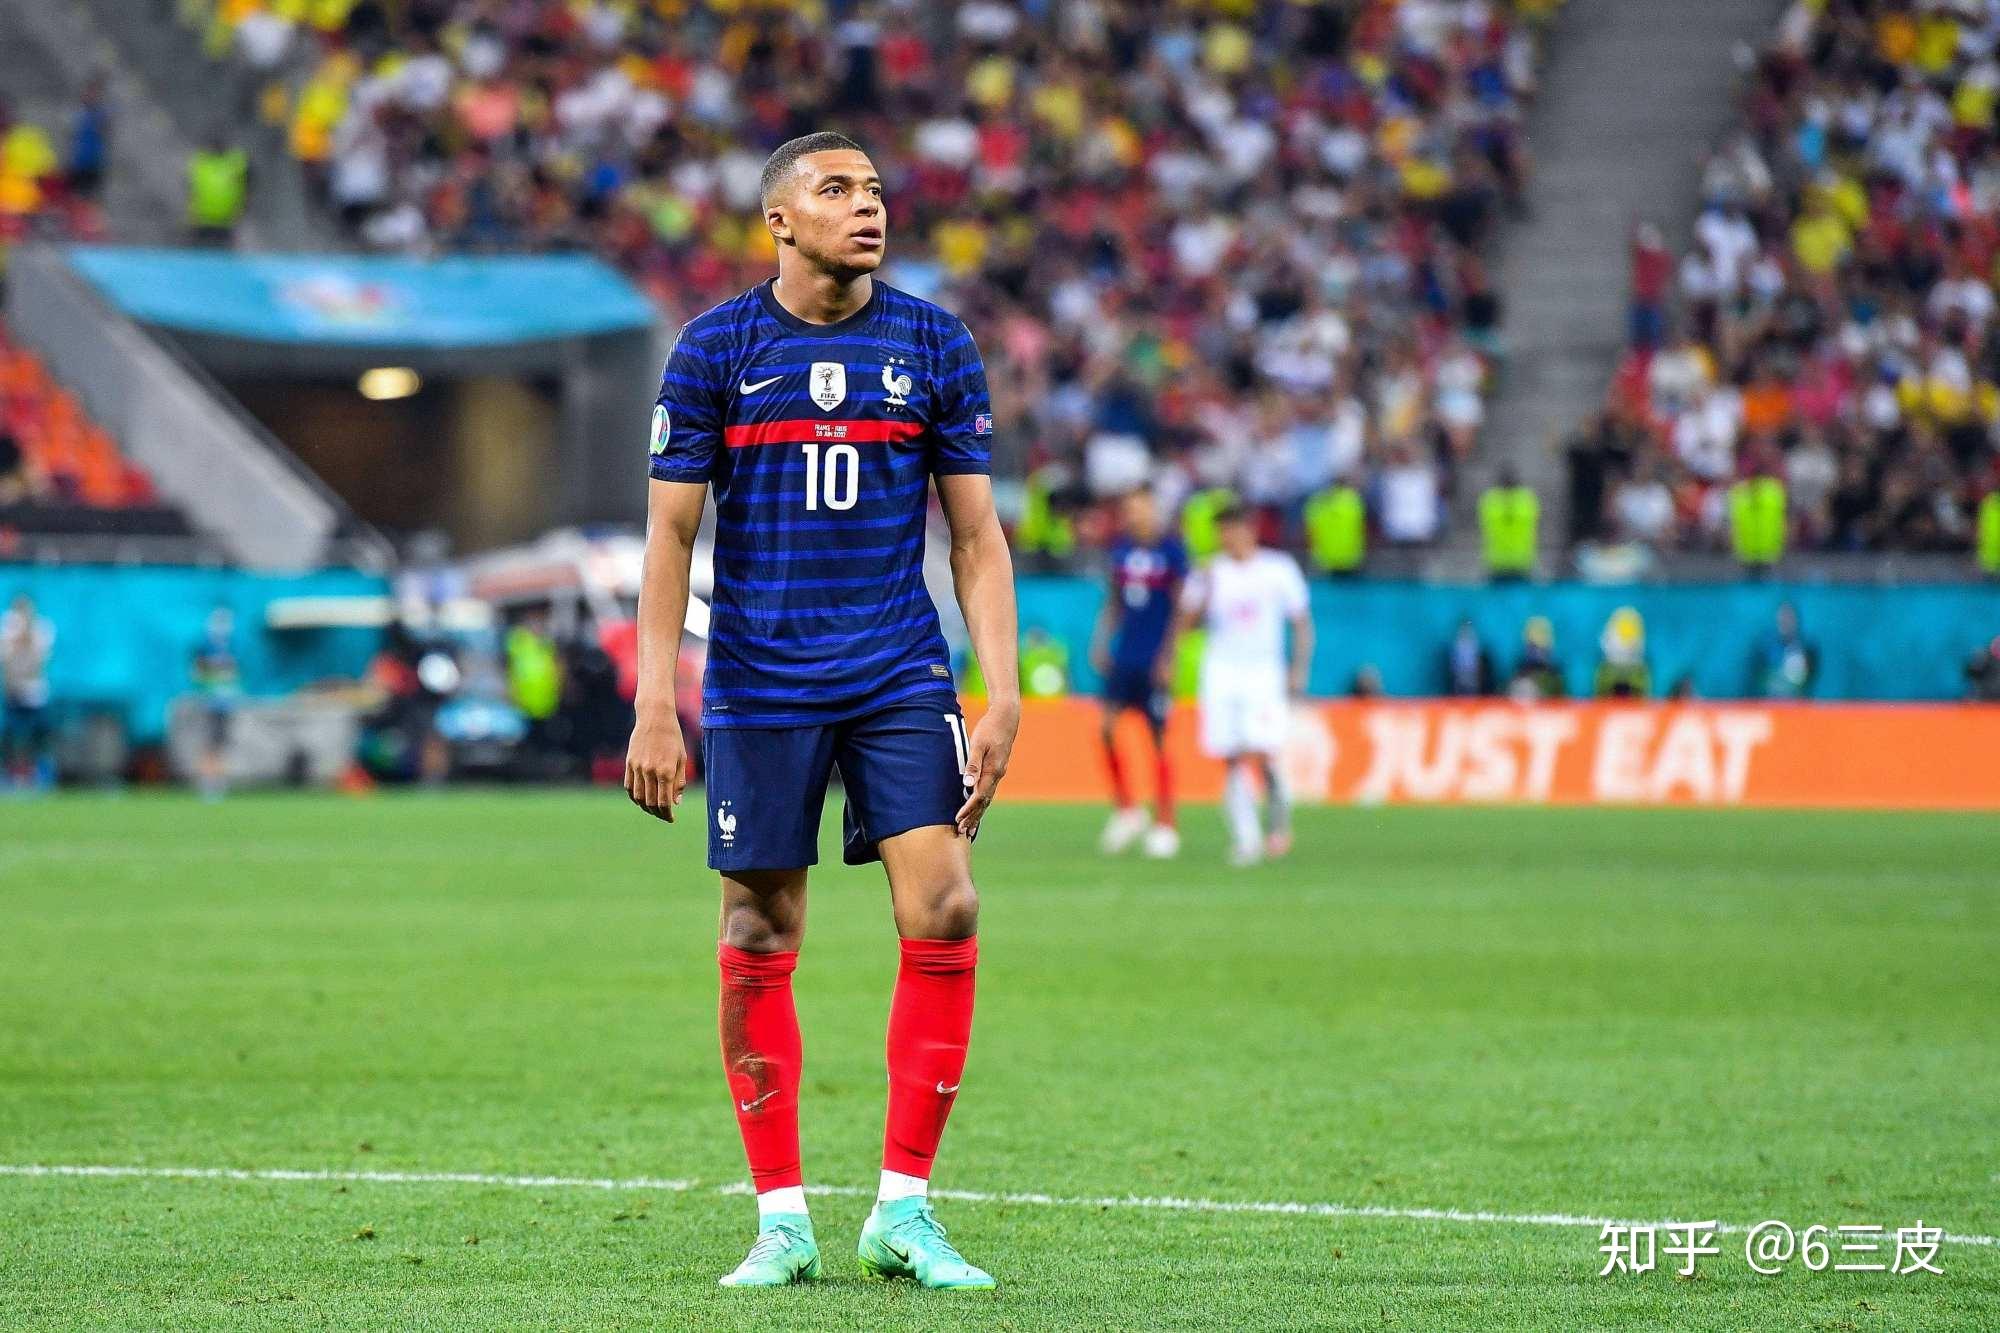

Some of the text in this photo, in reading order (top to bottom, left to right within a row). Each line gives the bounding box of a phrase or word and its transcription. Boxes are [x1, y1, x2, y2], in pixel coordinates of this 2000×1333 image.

[802, 443, 859, 511] 10
[1358, 709, 1772, 804] JUST EAT
